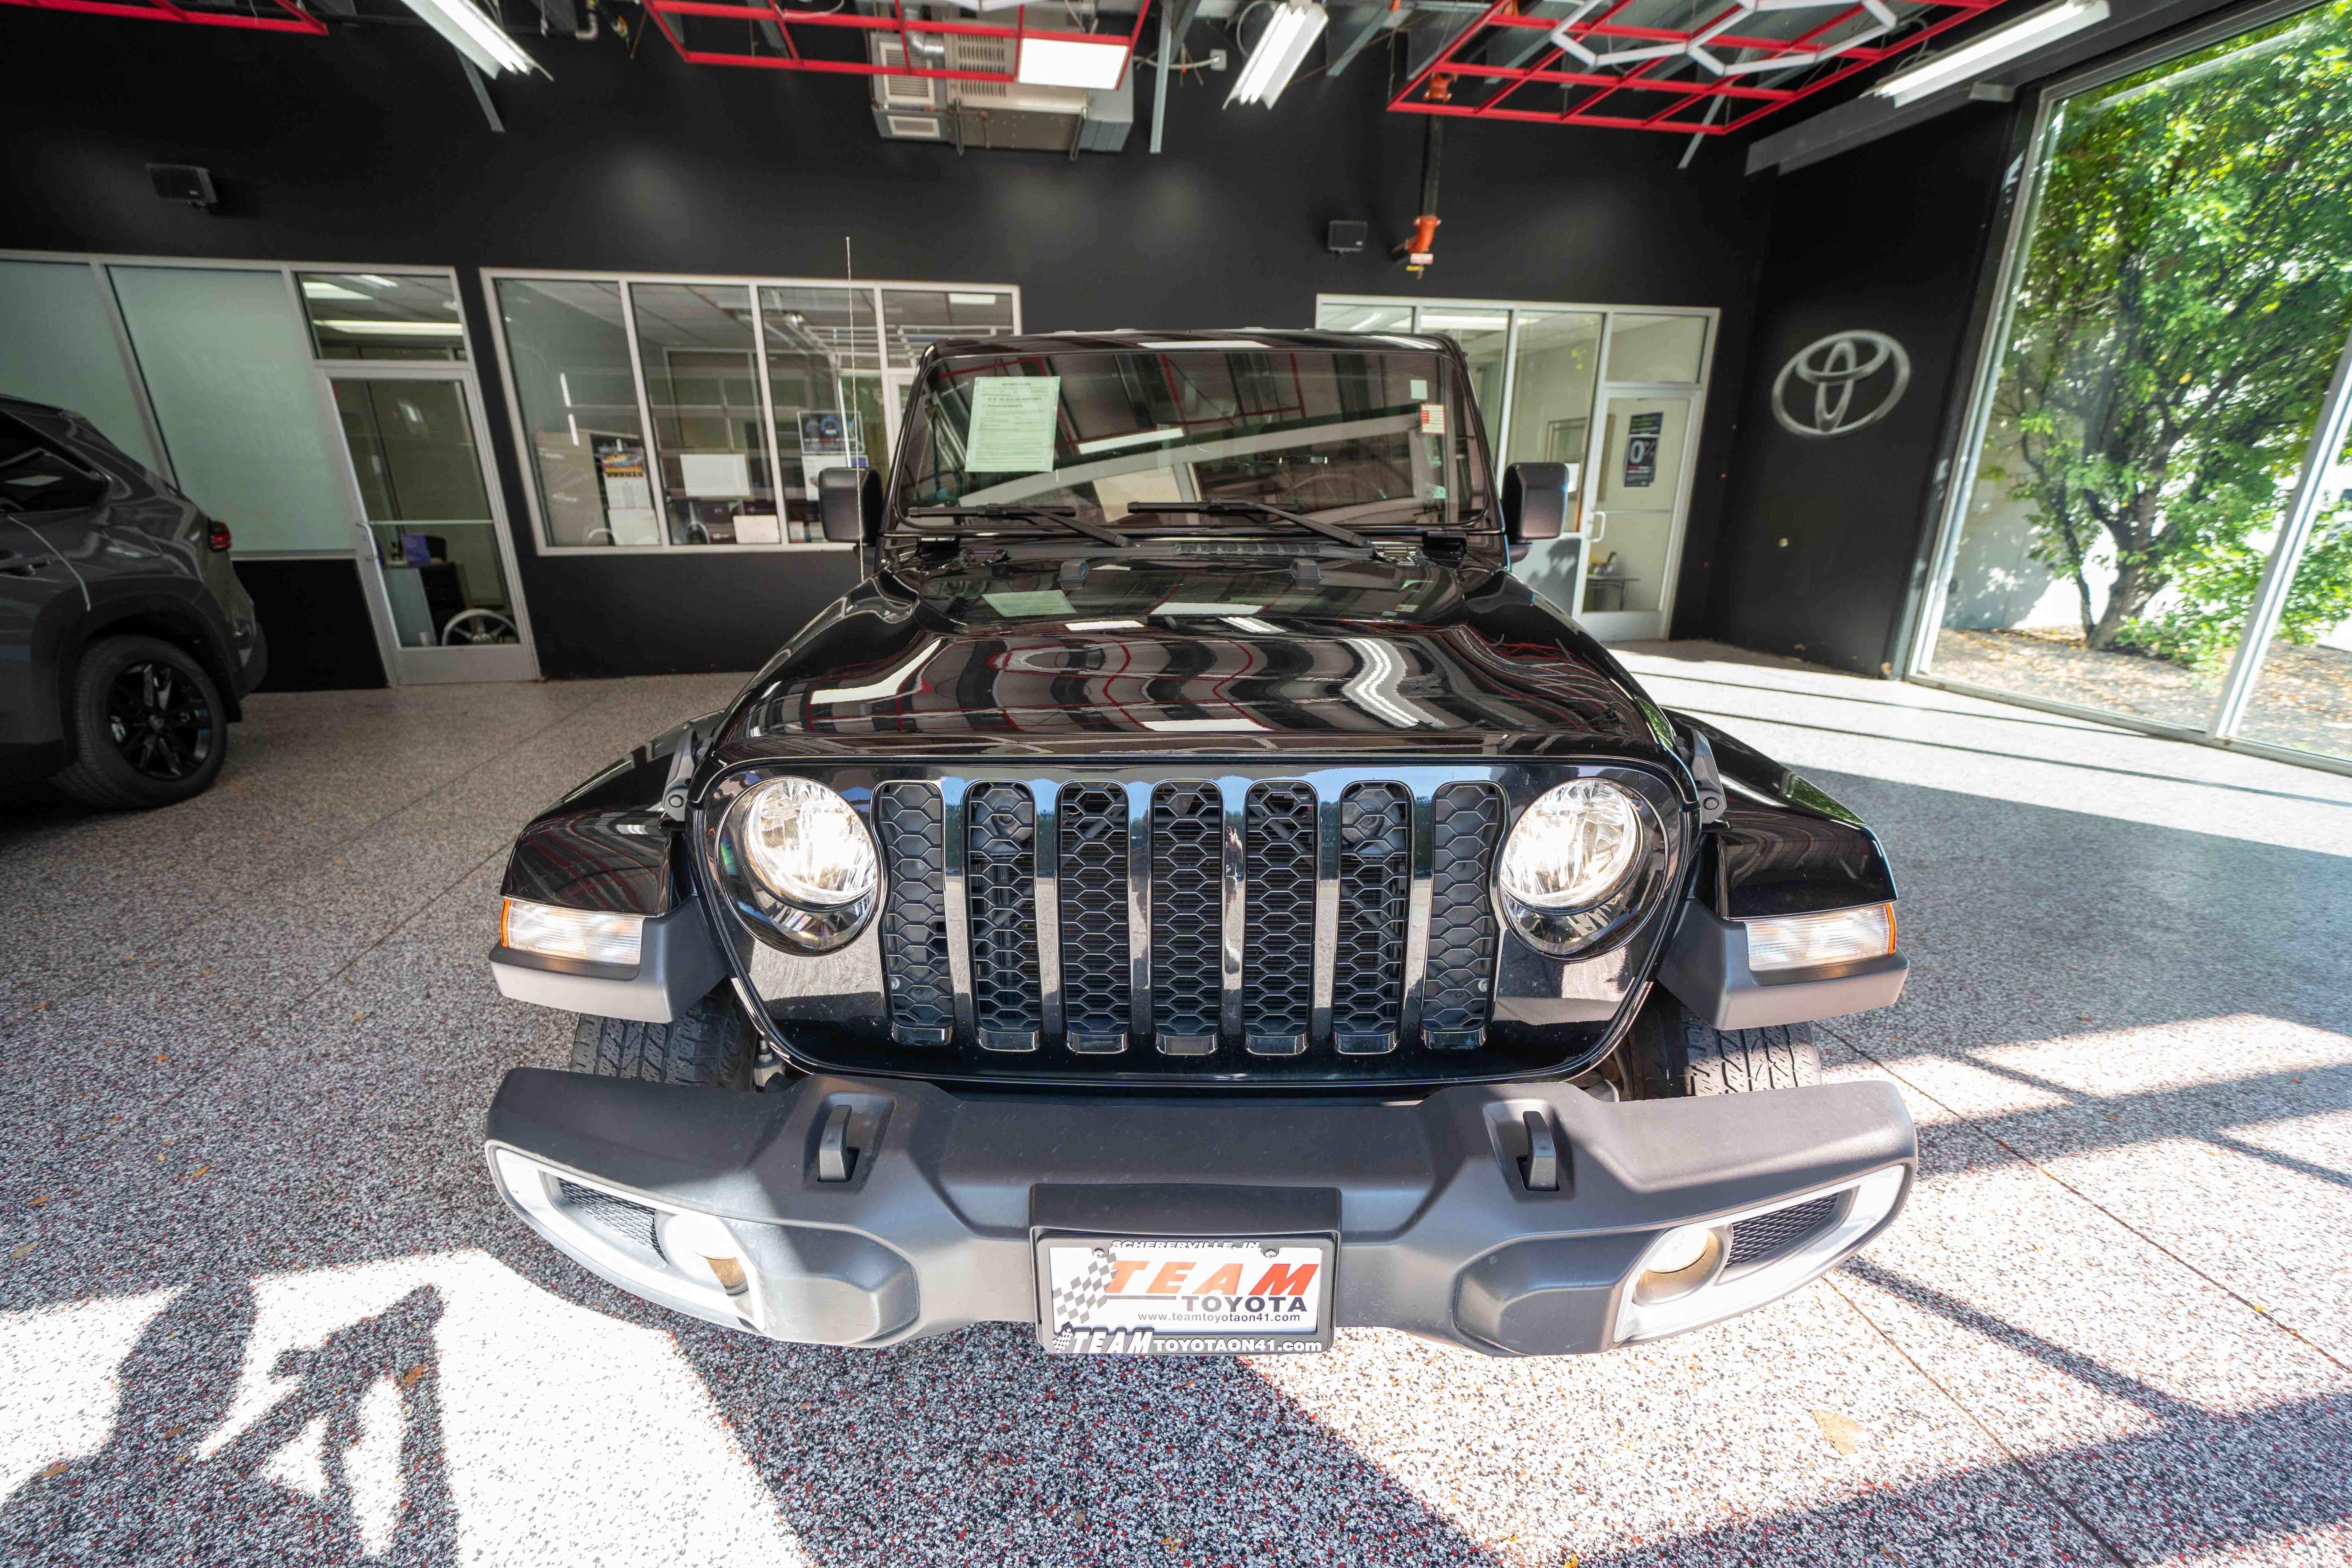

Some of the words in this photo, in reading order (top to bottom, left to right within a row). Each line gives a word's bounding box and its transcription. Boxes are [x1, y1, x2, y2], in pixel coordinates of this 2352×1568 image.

[1105, 1261, 1319, 1295] TEAM
[1182, 1296, 1307, 1312] TOYOTA
[1138, 1312, 1300, 1323] www.teamtoyotaon41.com
[1072, 1330, 1154, 1353] TEAM
[1153, 1338, 1322, 1352] TOYOTAON41.com
